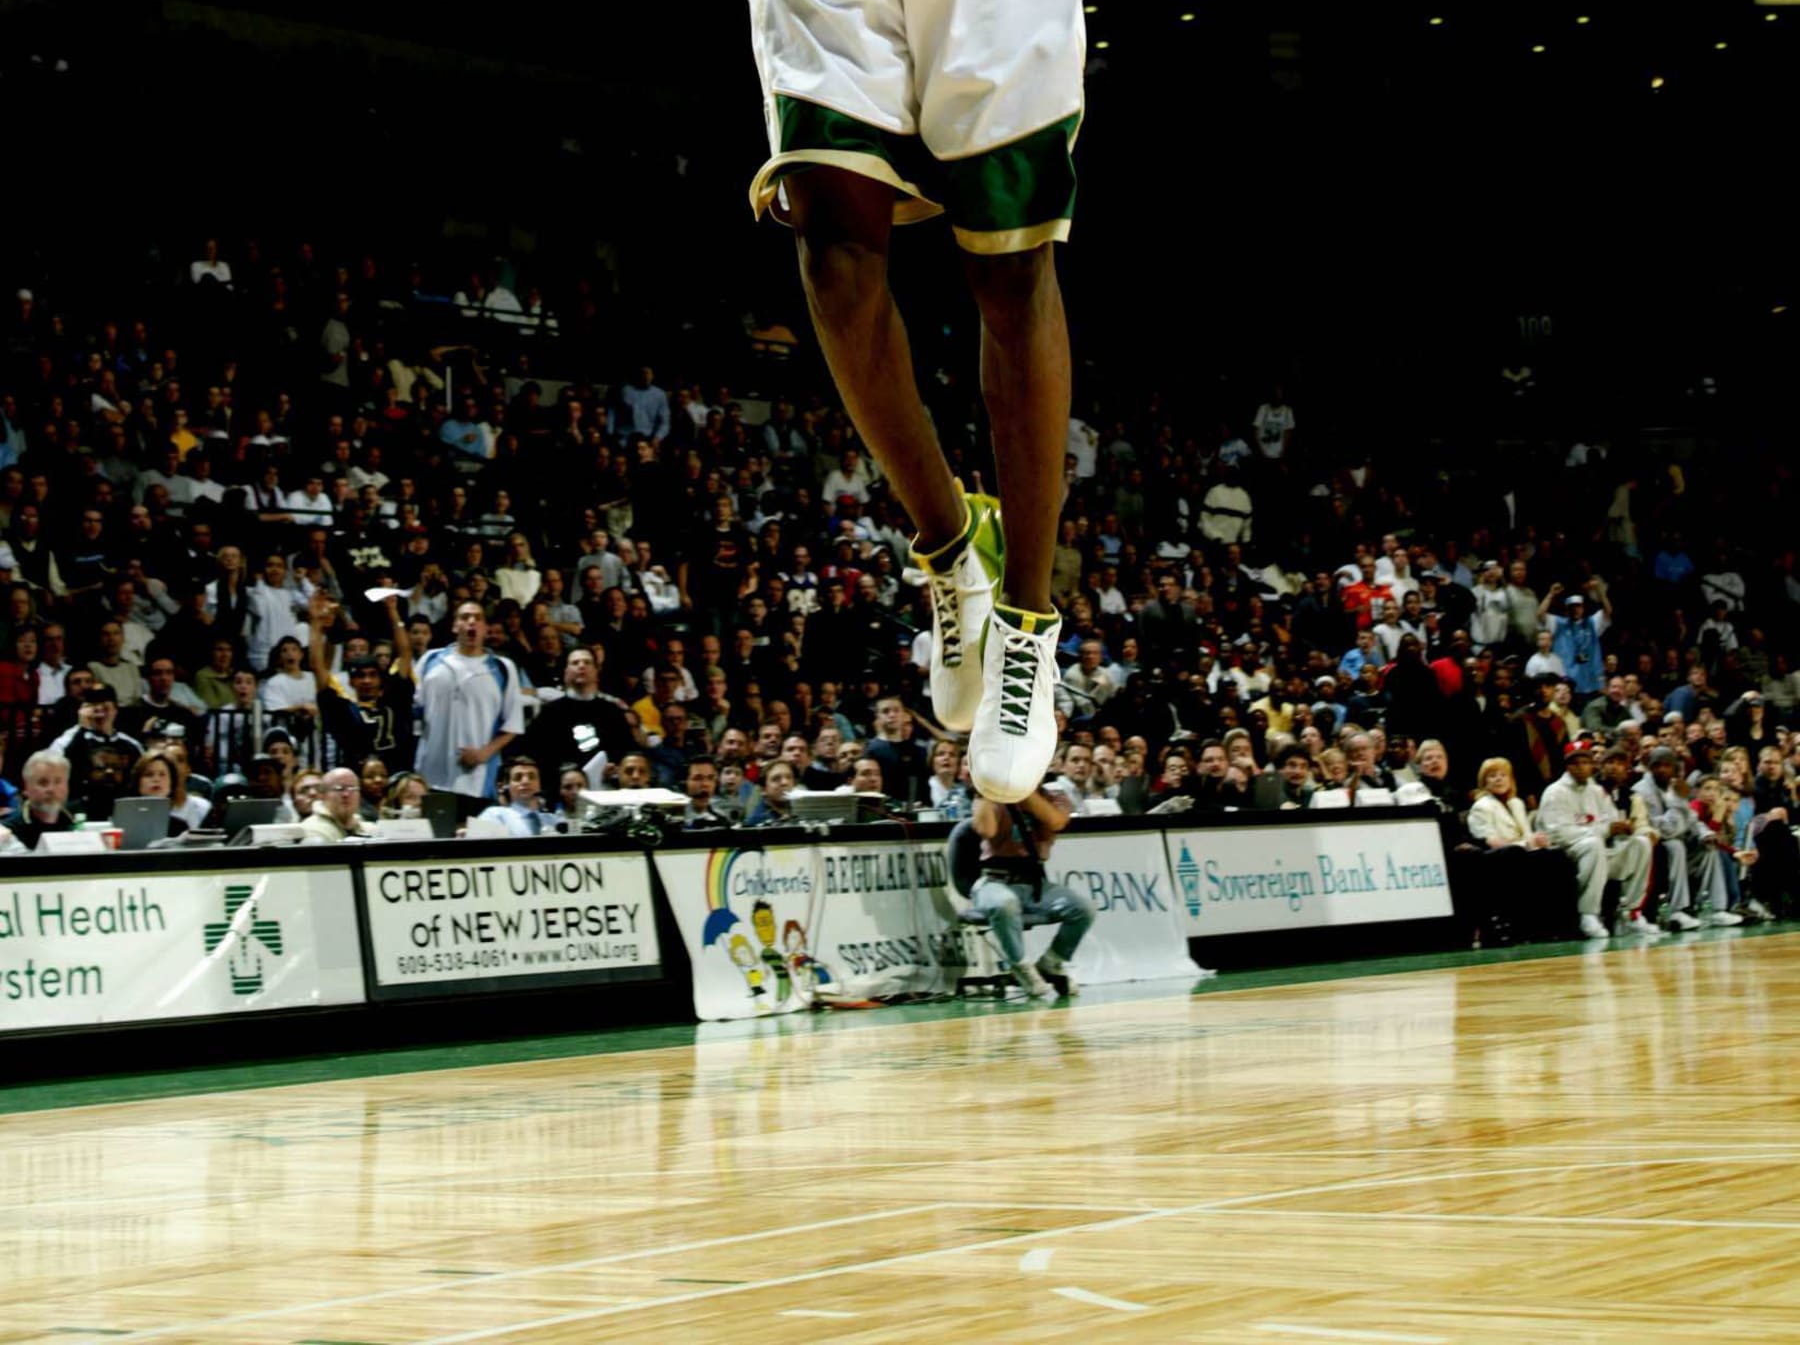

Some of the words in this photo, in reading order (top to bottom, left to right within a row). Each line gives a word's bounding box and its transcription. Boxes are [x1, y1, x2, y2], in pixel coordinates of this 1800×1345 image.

[379, 866, 496, 903] CREDIT
[507, 862, 604, 896] UNION
[734, 866, 812, 896] Children's
[825, 853, 911, 894] REGULAR
[1204, 859, 1315, 912] Sovereign
[1316, 853, 1377, 896] Bank
[1384, 854, 1446, 890] Arena
[35, 887, 166, 937] Health
[411, 915, 441, 948] of
[452, 909, 523, 945] NEW
[530, 903, 640, 940] JERSEY
[0, 958, 103, 1000] stem
